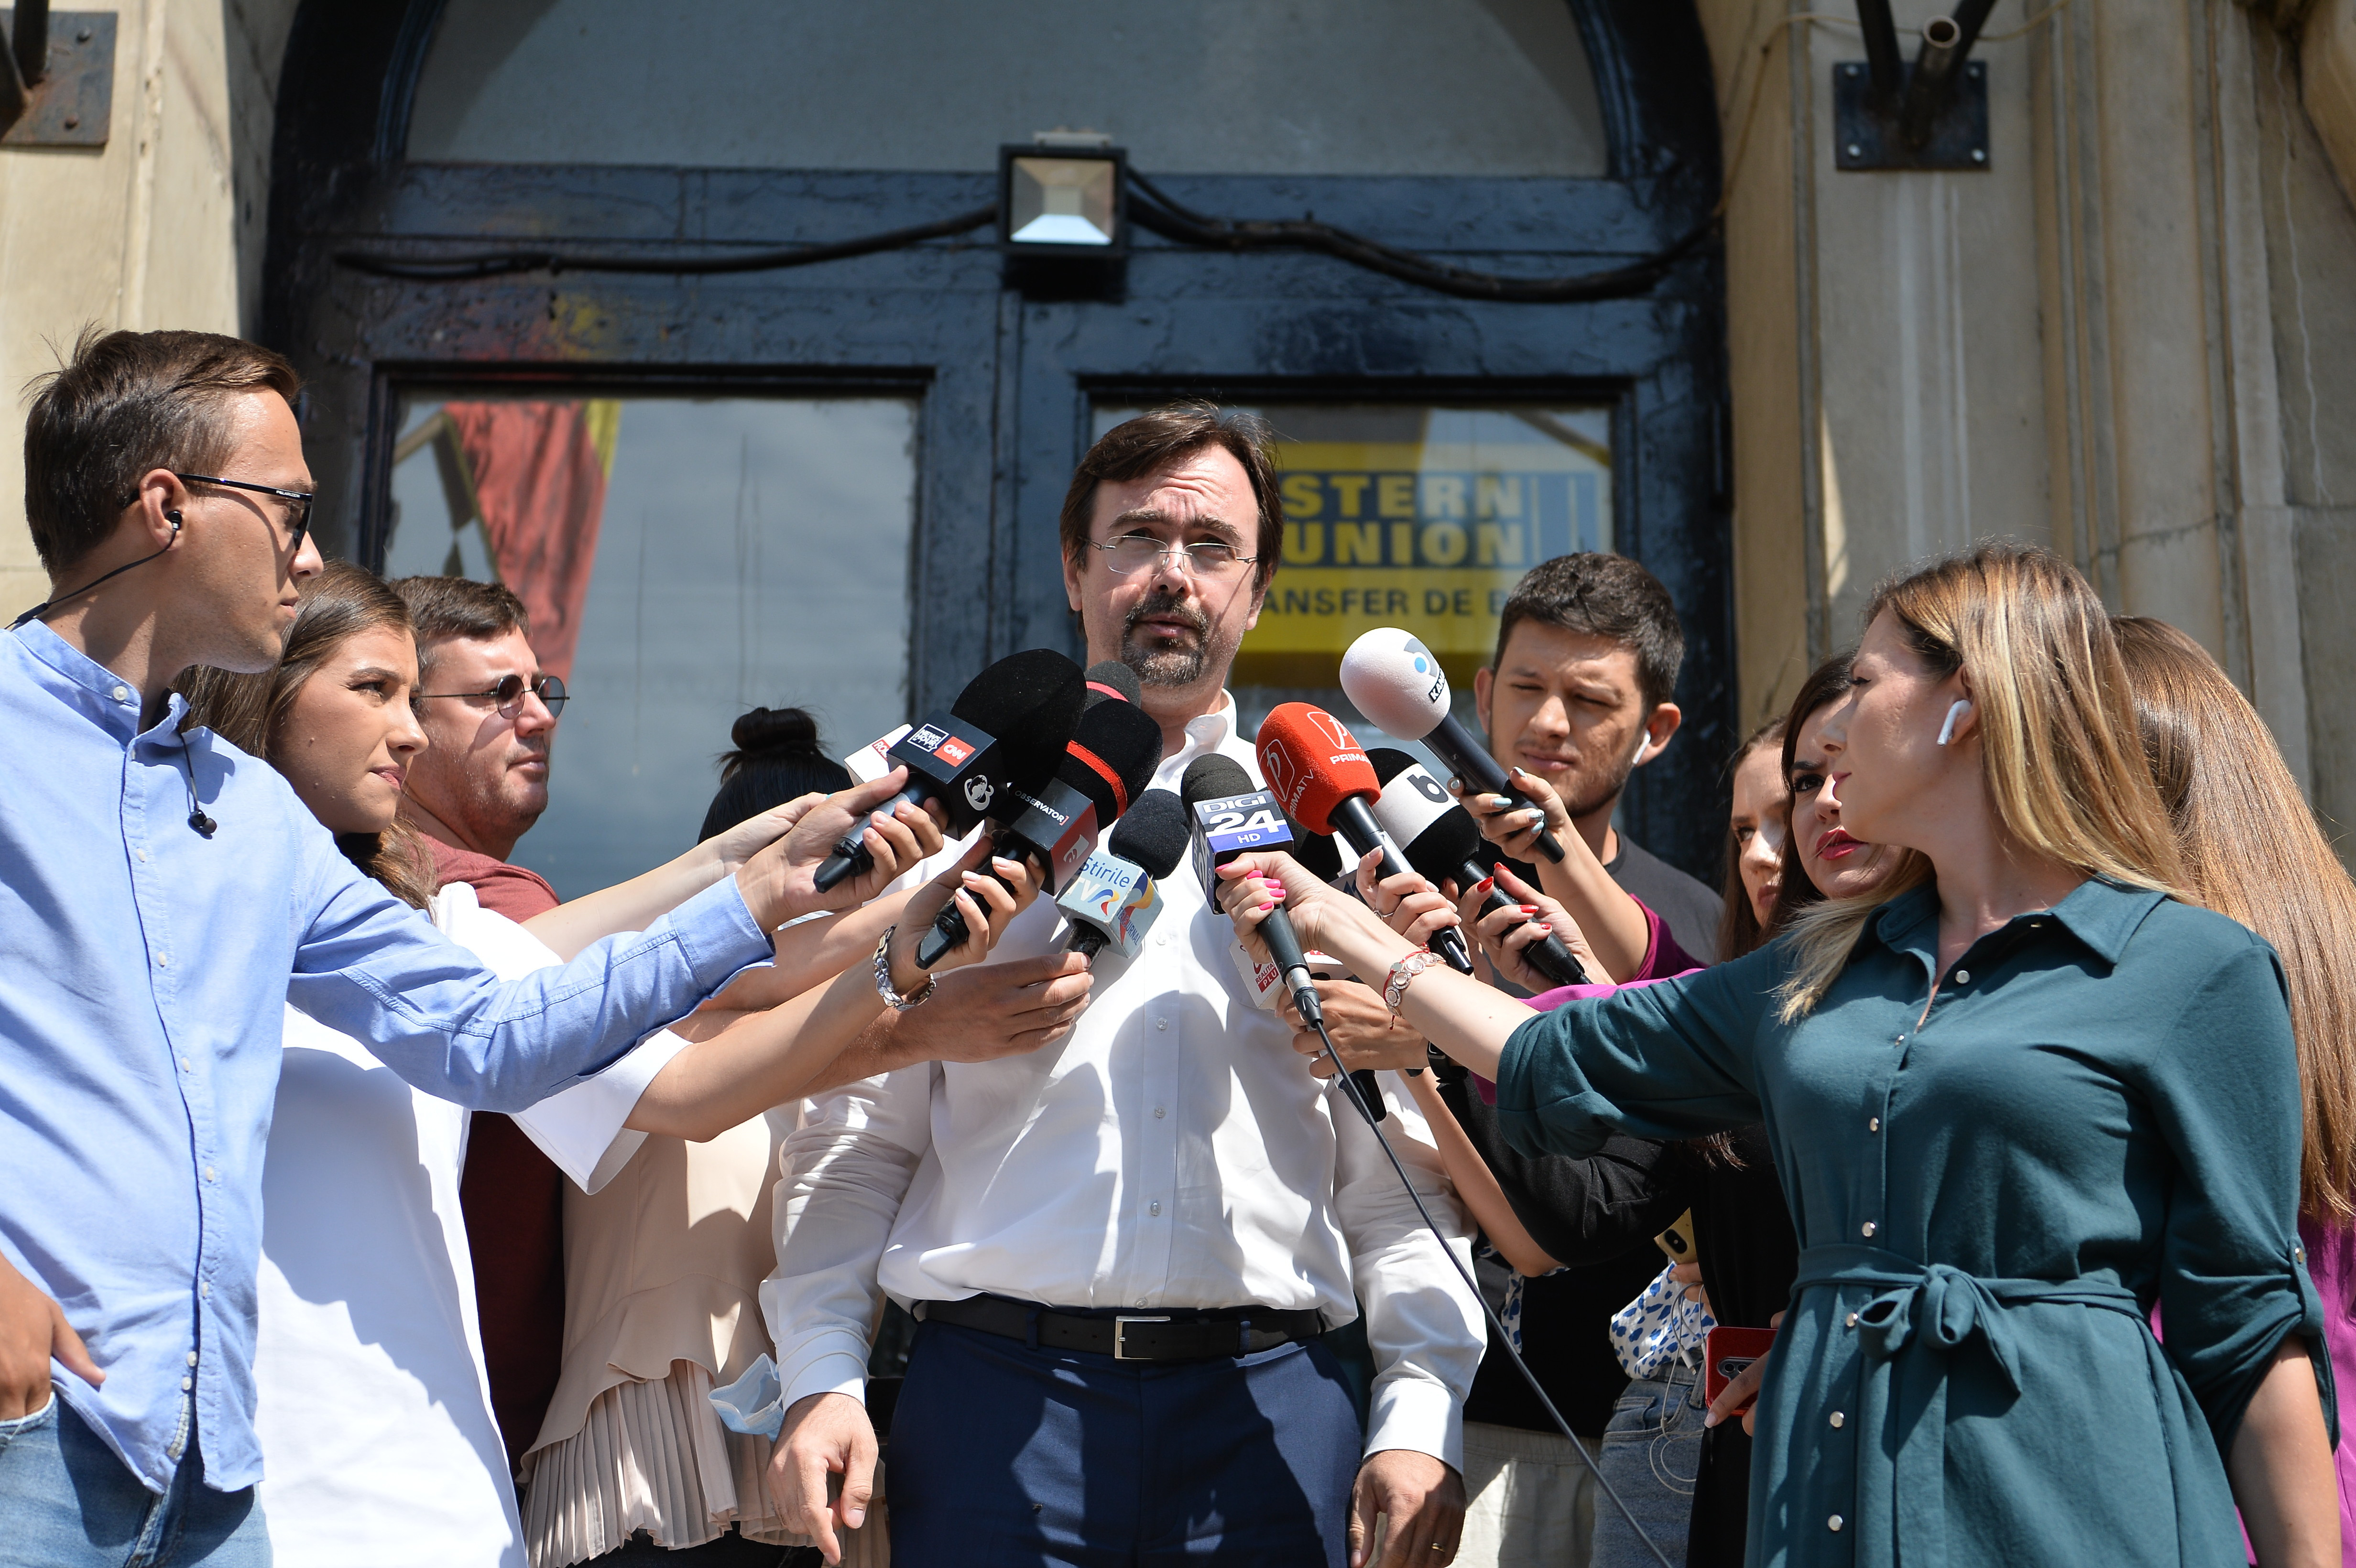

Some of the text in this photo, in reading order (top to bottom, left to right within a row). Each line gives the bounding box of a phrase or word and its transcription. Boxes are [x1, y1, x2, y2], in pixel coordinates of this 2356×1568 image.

[1281, 474, 1522, 519] STERN
[1282, 522, 1523, 565] UNION
[1262, 588, 1408, 617] ANSFER
[1425, 588, 1472, 617] DE
[914, 733, 937, 747] HOUR
[919, 729, 942, 742] NEWS
[943, 744, 967, 760] CNN
[1202, 795, 1267, 813] DIGI
[1205, 809, 1287, 838] 24
[1237, 833, 1261, 844] HD
[1255, 961, 1275, 984] REALITA
[1263, 969, 1277, 988] PLU
